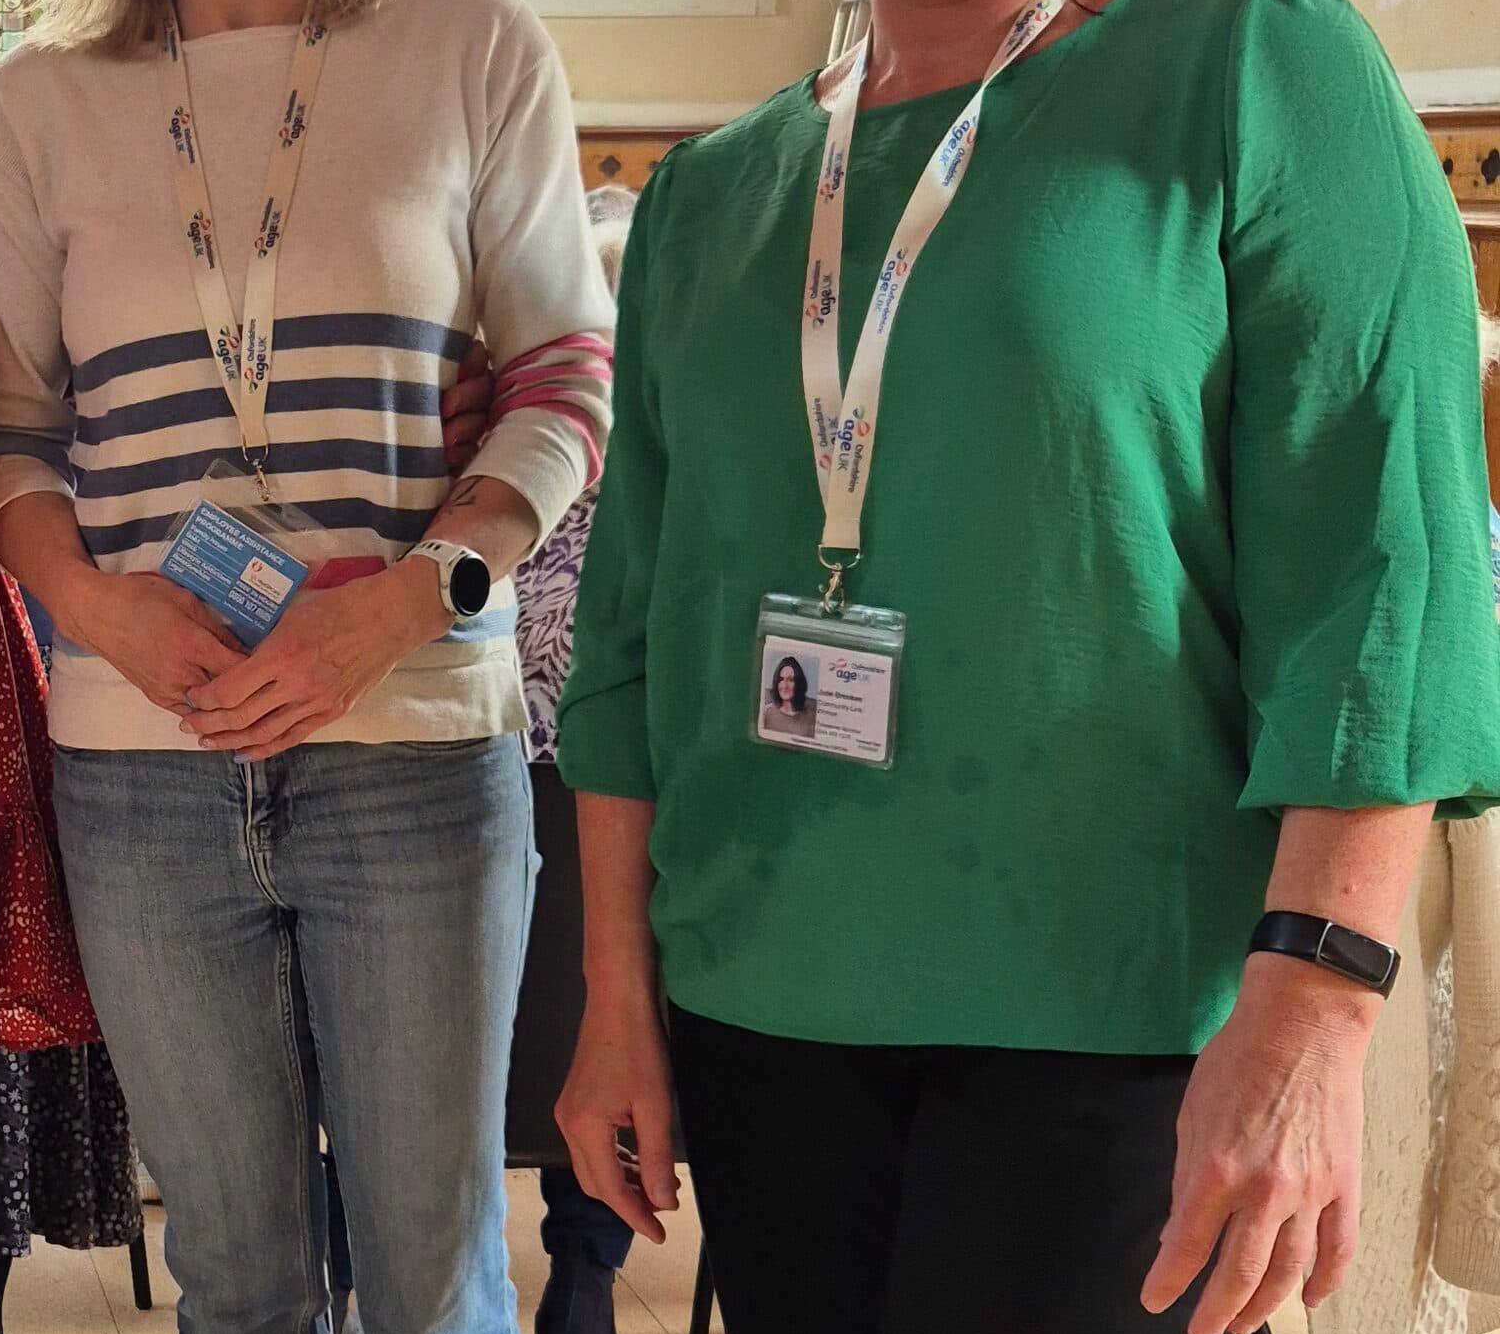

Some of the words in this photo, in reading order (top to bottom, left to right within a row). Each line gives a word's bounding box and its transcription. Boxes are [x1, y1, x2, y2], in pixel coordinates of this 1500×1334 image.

[195, 516, 244, 550] PROGRAMME
[200, 508, 240, 537] EMPLOYEE
[240, 534, 285, 566] ASSISTANCE
